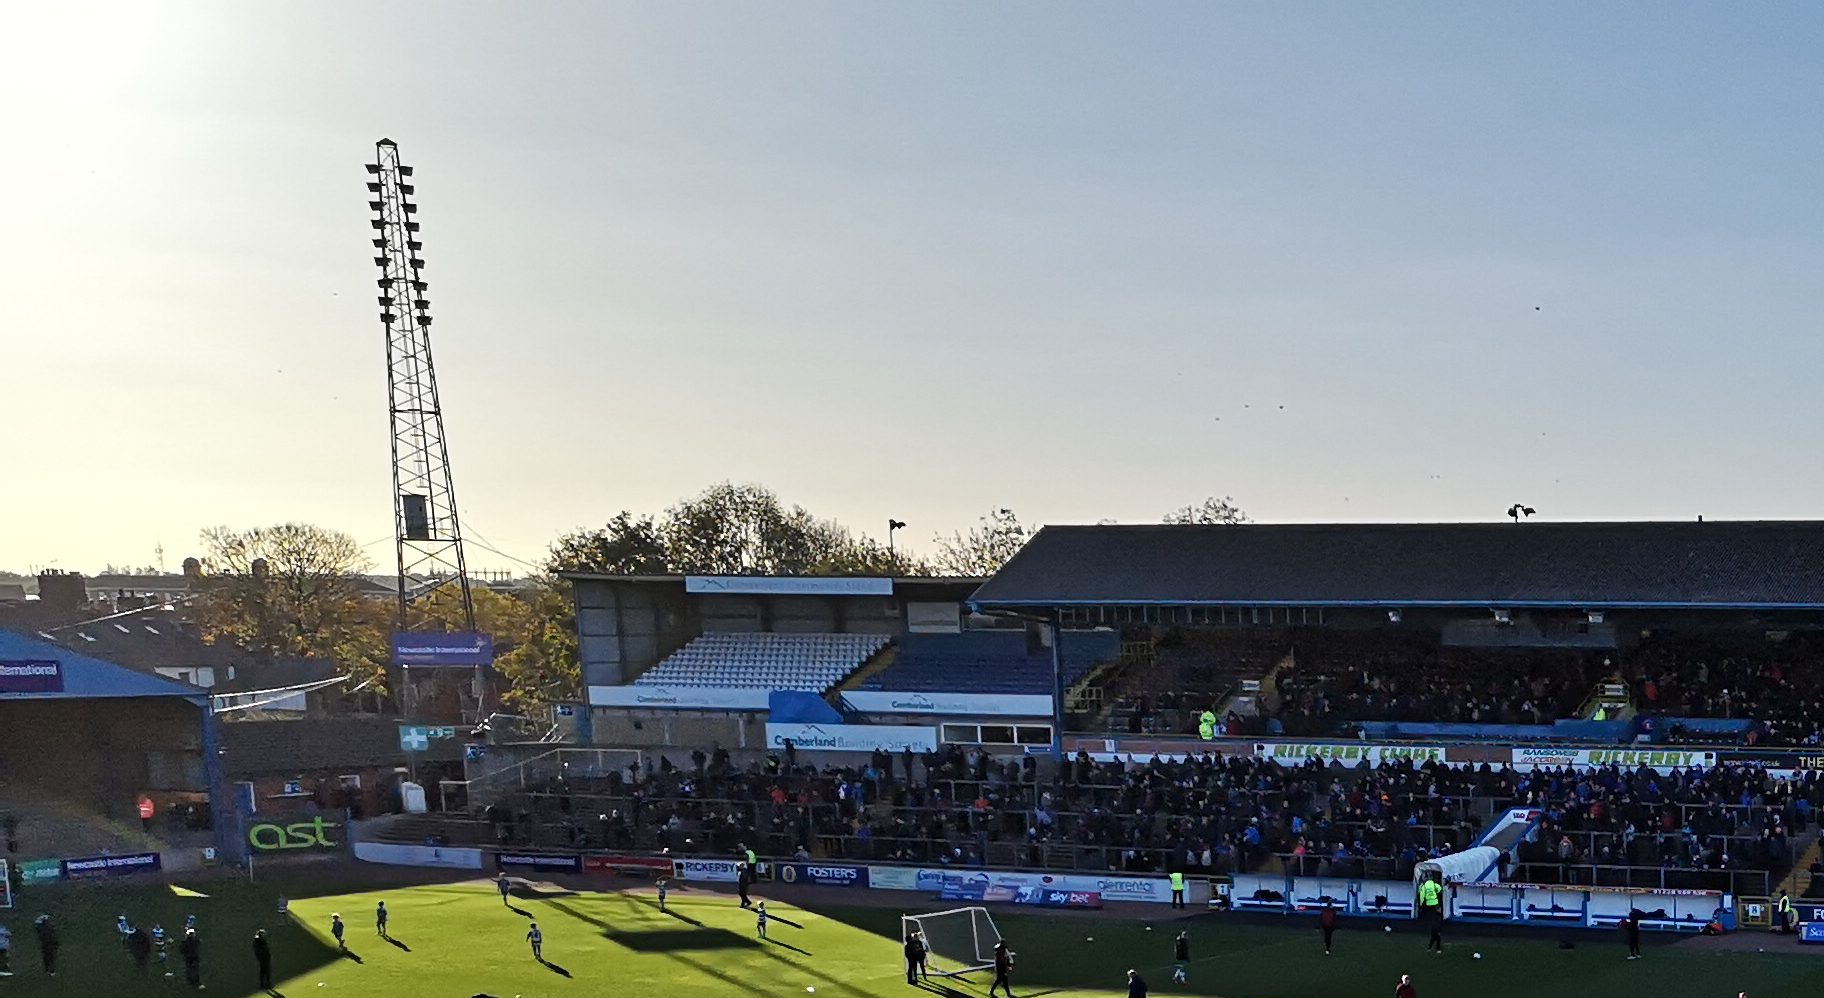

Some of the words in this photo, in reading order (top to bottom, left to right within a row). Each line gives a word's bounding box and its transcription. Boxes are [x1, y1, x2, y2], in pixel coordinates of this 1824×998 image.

[1274, 744, 1373, 759] RICKERBY
[1588, 750, 1693, 766] RICKERBY
[1799, 757, 1824, 769] THE
[685, 861, 737, 872] RICKERBY
[807, 866, 857, 879] FOSTER'S
[1049, 891, 1068, 904] sky
[1070, 892, 1090, 904] bet
